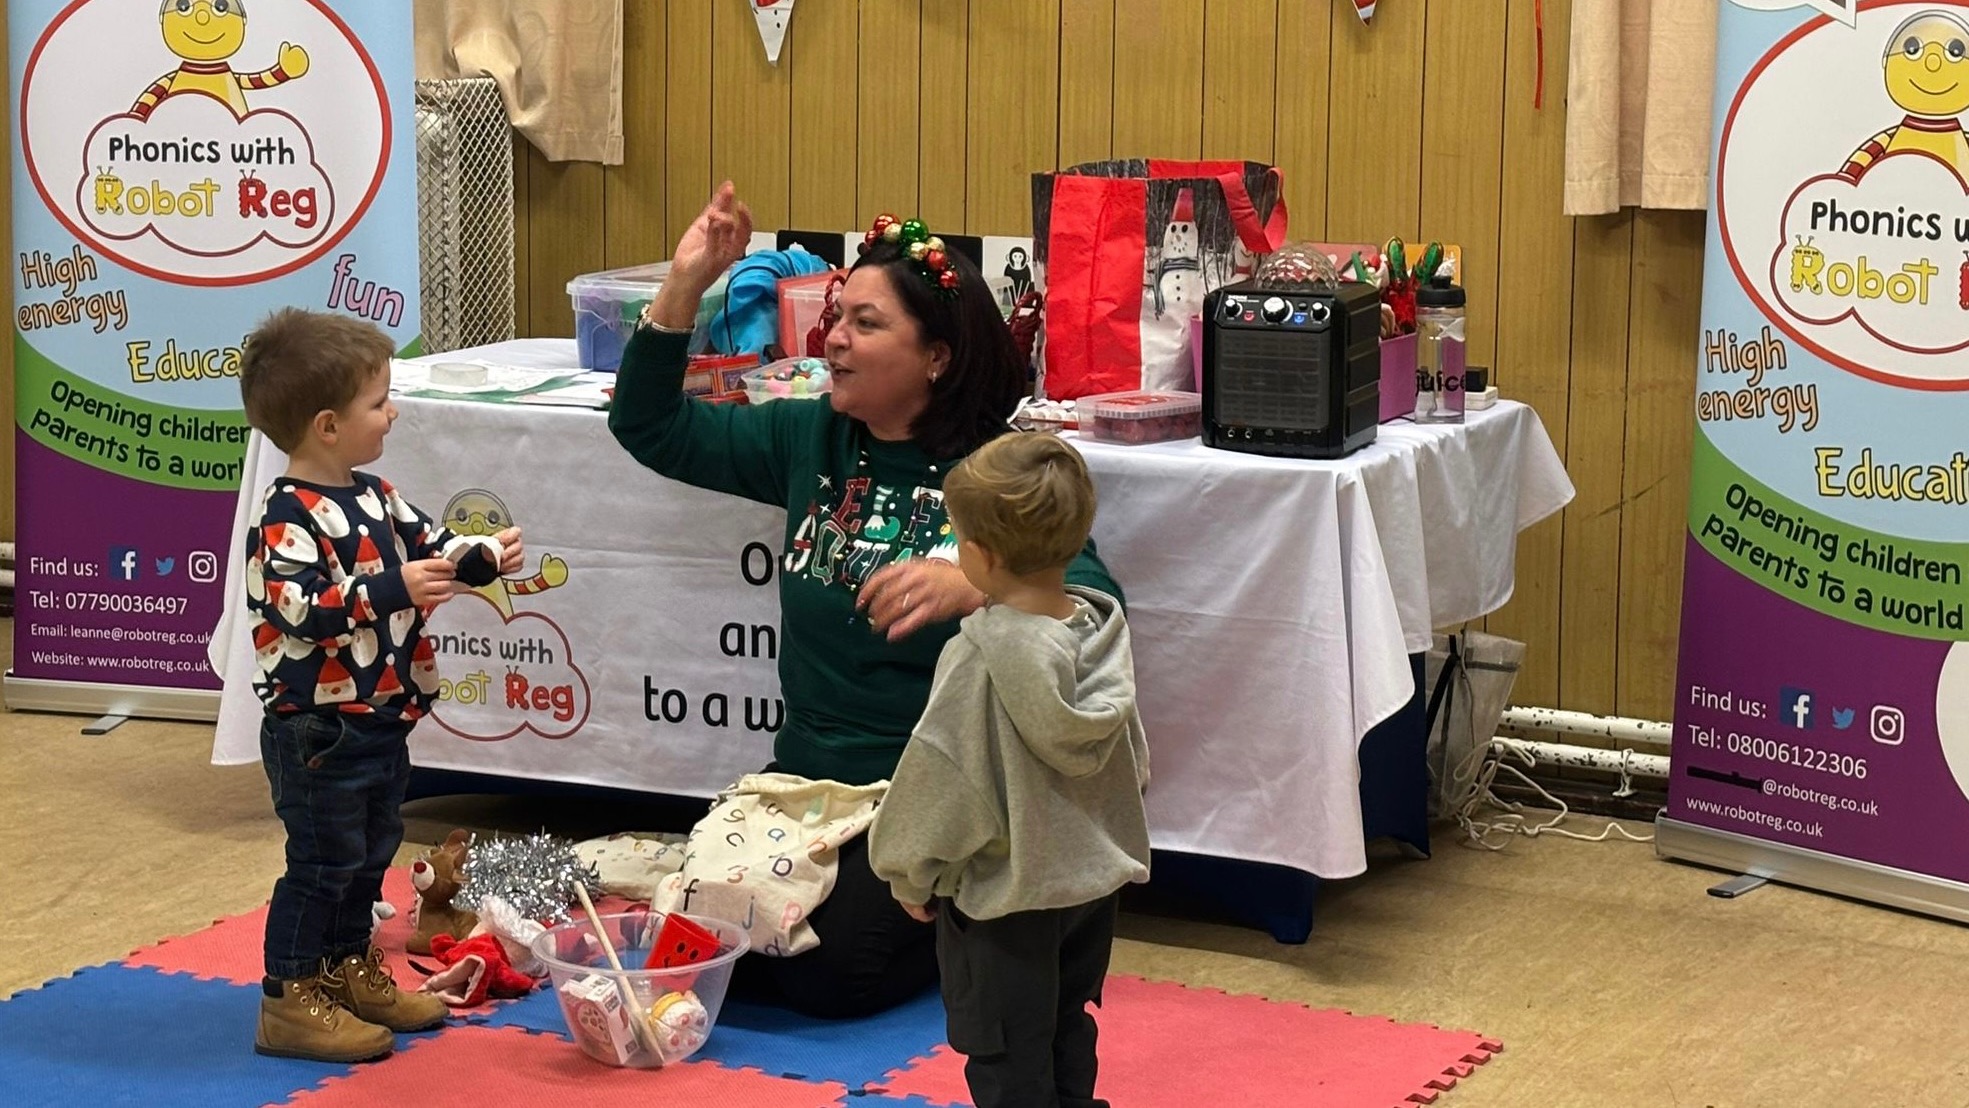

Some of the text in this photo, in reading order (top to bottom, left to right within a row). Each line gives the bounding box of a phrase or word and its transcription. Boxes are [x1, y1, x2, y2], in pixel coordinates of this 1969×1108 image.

[109, 134, 295, 165] Phonics with
[95, 168, 318, 229] Robot Reg
[1811, 199, 1942, 241] Phonics
[21, 244, 98, 298] High
[328, 253, 405, 327] fun
[1790, 237, 1938, 305] Robot
[17, 289, 128, 334] energy
[126, 336, 246, 384] Educa
[1705, 326, 1787, 387] High
[51, 380, 152, 437] Opening
[1699, 384, 1819, 433] energy
[30, 408, 244, 481] parents to a worl
[1814, 447, 1969, 505] Educat
[1725, 483, 1960, 585] Opening children
[30, 556, 68, 576] Find
[73, 562, 99, 577] us:
[1701, 513, 1963, 630] parents to a world
[29, 590, 188, 615] Tel: 07790036497
[31, 623, 212, 645] Email: leanne@robotreg.co.uk
[500, 638, 553, 664] with
[719, 622, 776, 659] an
[31, 651, 210, 673] Website: www.robotreg.co.uk
[505, 668, 575, 722] Reg
[643, 675, 687, 724] to
[702, 692, 728, 727] a
[1691, 685, 1732, 712] Find
[1739, 697, 1767, 719] us:
[1688, 725, 1867, 780] Tel: 08006122306
[1686, 797, 1824, 838] www.robotreg.co.uk
[1763, 779, 1878, 816] @robotreg.co.uk
[683, 878, 700, 911] f
[742, 895, 755, 930] j
